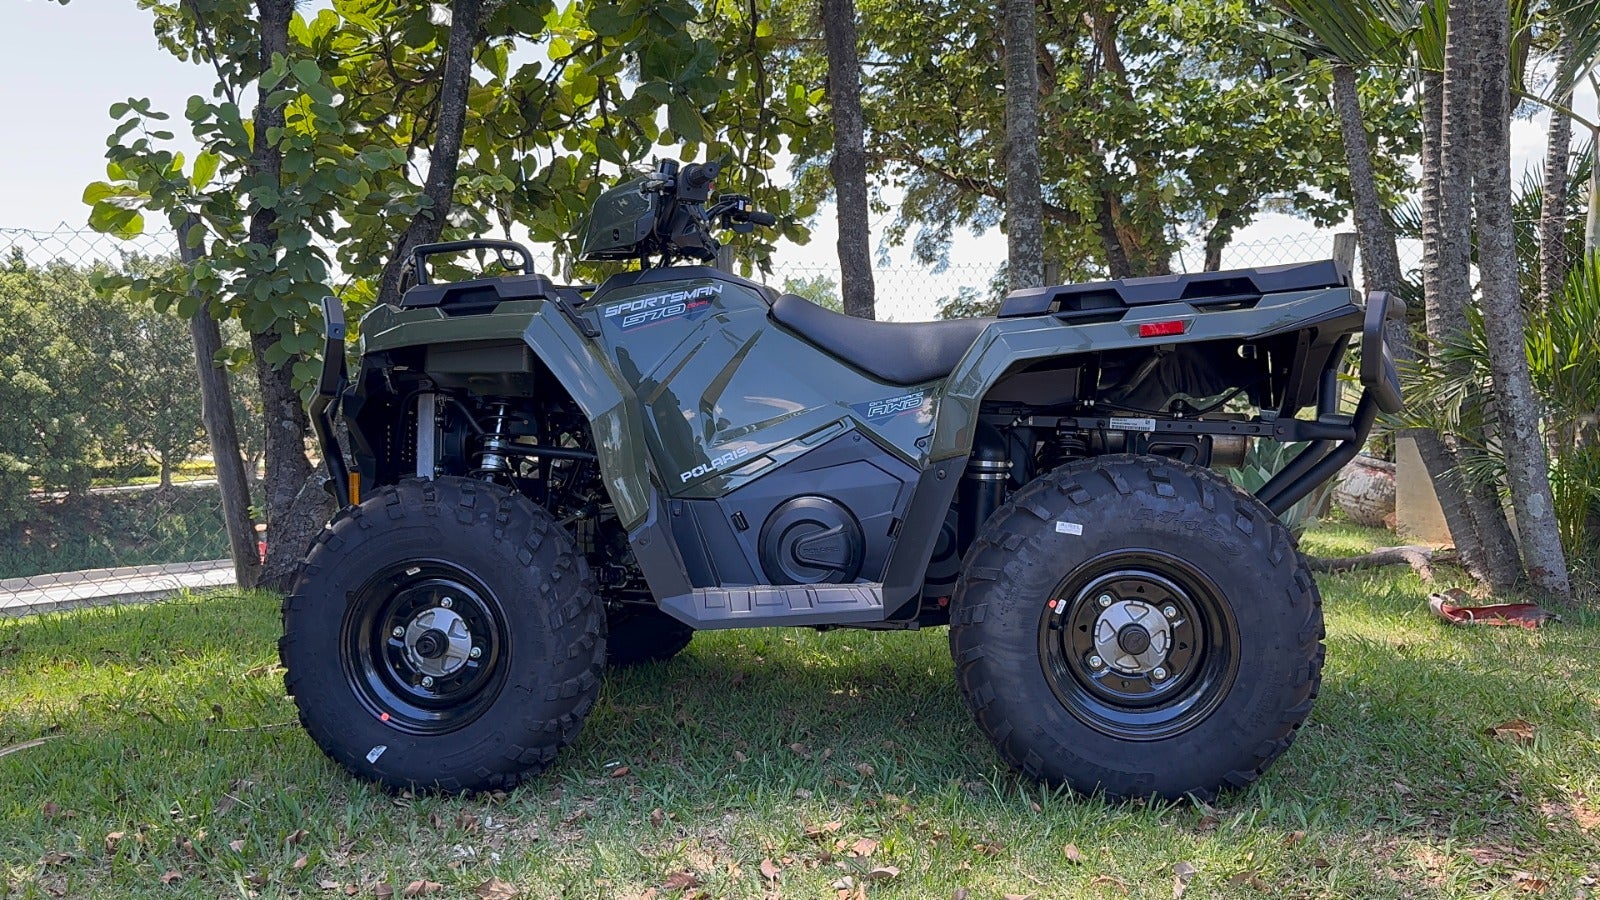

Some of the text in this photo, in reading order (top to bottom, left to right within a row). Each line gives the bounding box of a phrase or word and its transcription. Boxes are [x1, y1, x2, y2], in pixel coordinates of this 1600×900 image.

[604, 284, 723, 318] SPORTSMAN
[622, 303, 686, 327] 570
[867, 396, 924, 417] AWD
[680, 446, 749, 483] POLARIS
